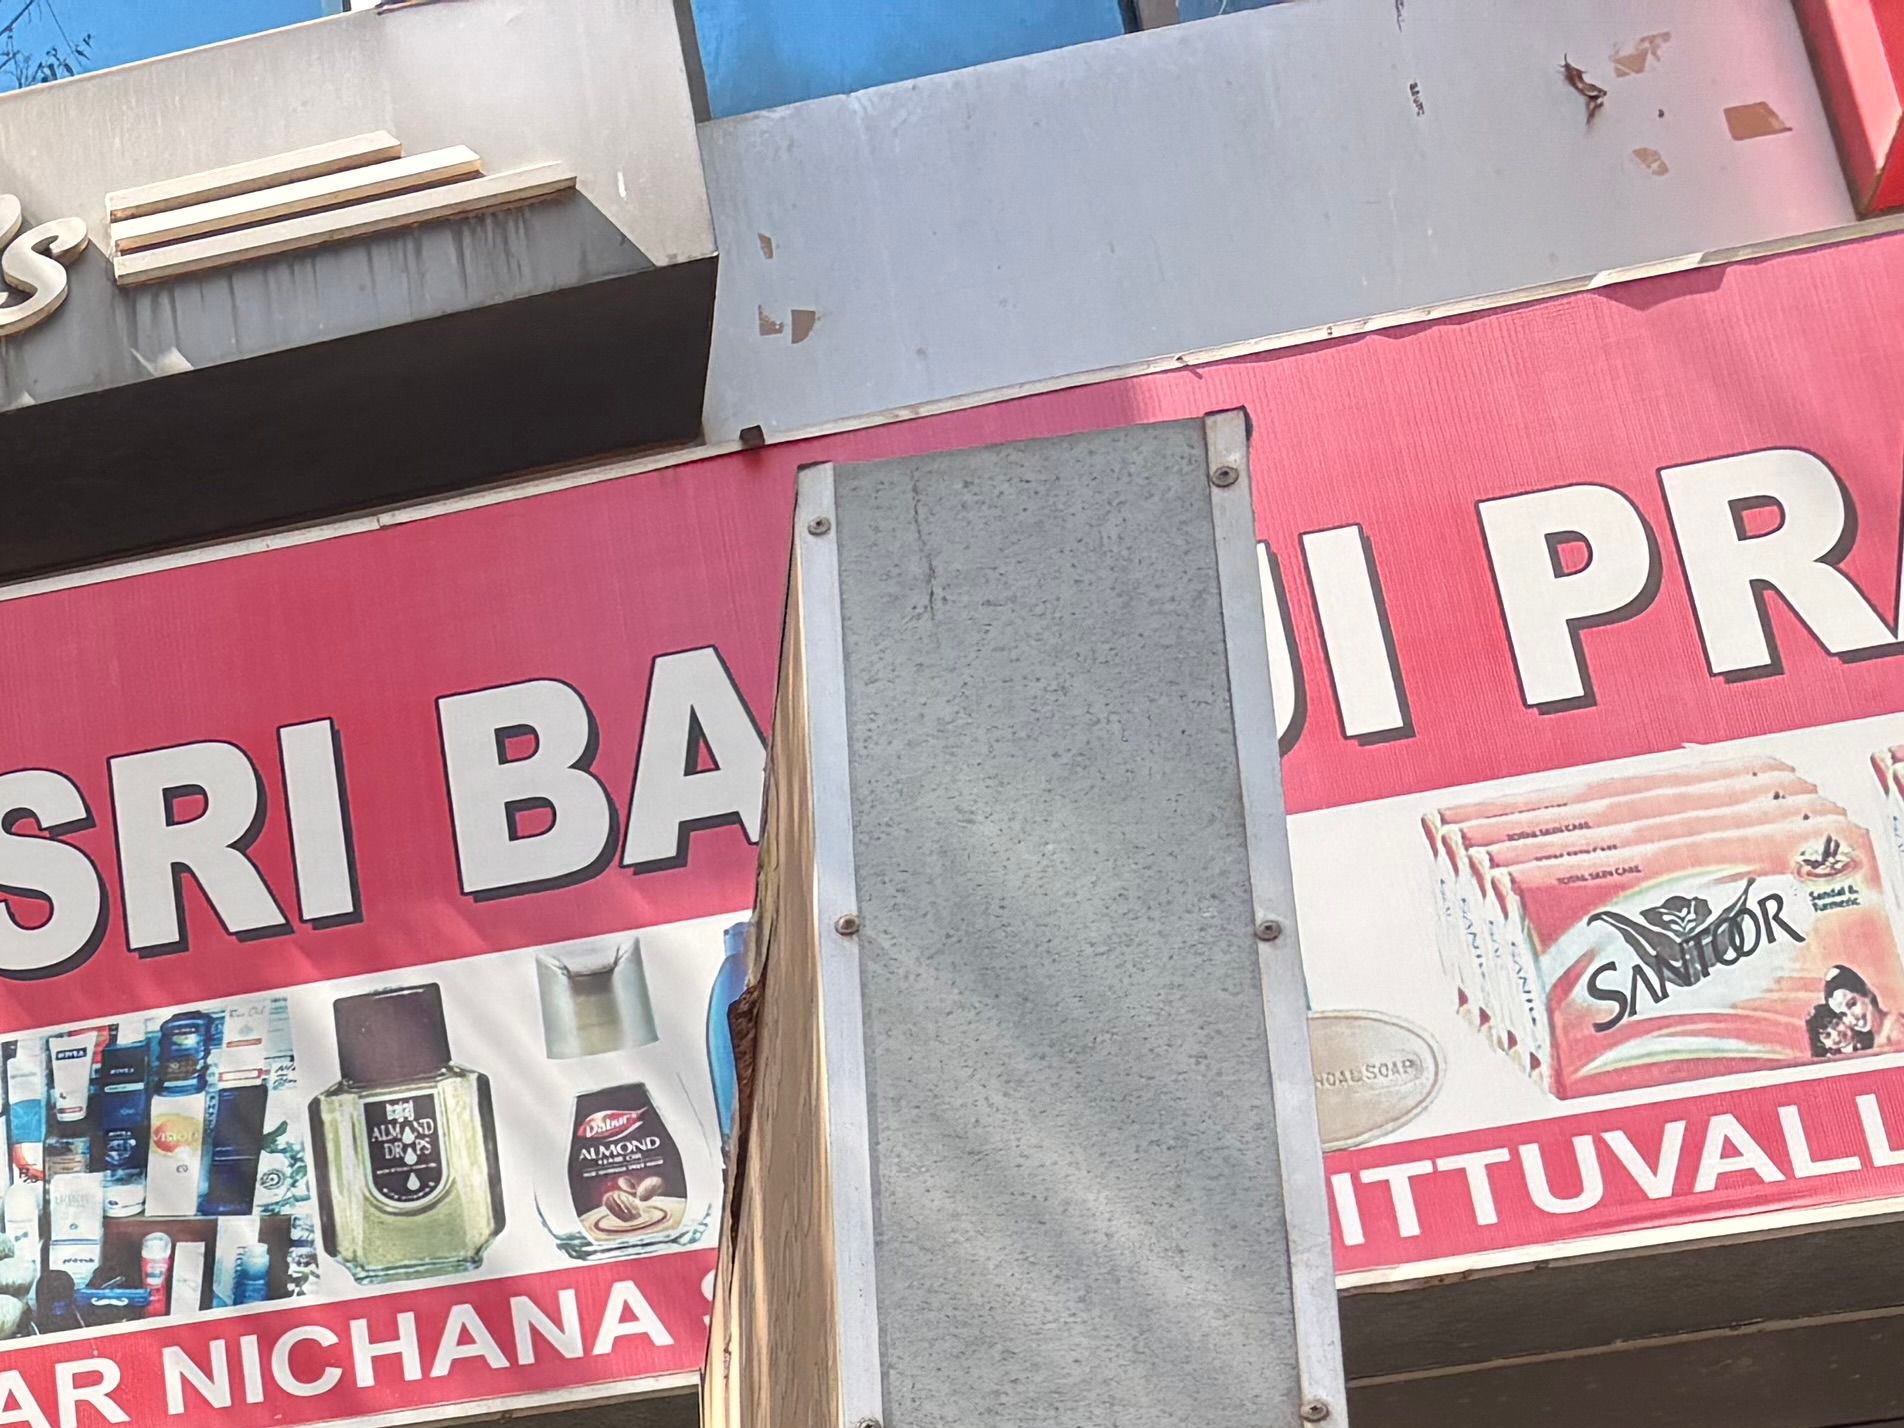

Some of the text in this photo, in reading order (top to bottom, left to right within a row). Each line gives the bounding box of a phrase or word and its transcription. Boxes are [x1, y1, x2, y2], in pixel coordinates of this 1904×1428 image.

[1478, 447, 1904, 713] PR
[1556, 864, 1642, 886] TOTAL SKIN CARE
[1586, 892, 1807, 1033] SANTOOR
[1364, 1059, 1416, 1082] SOAP
[585, 1111, 639, 1138] Dabur
[578, 1136, 661, 1162] ALMOND
[162, 1280, 675, 1418] NICHANA
[1330, 1094, 1904, 1247] ITTUVALL
